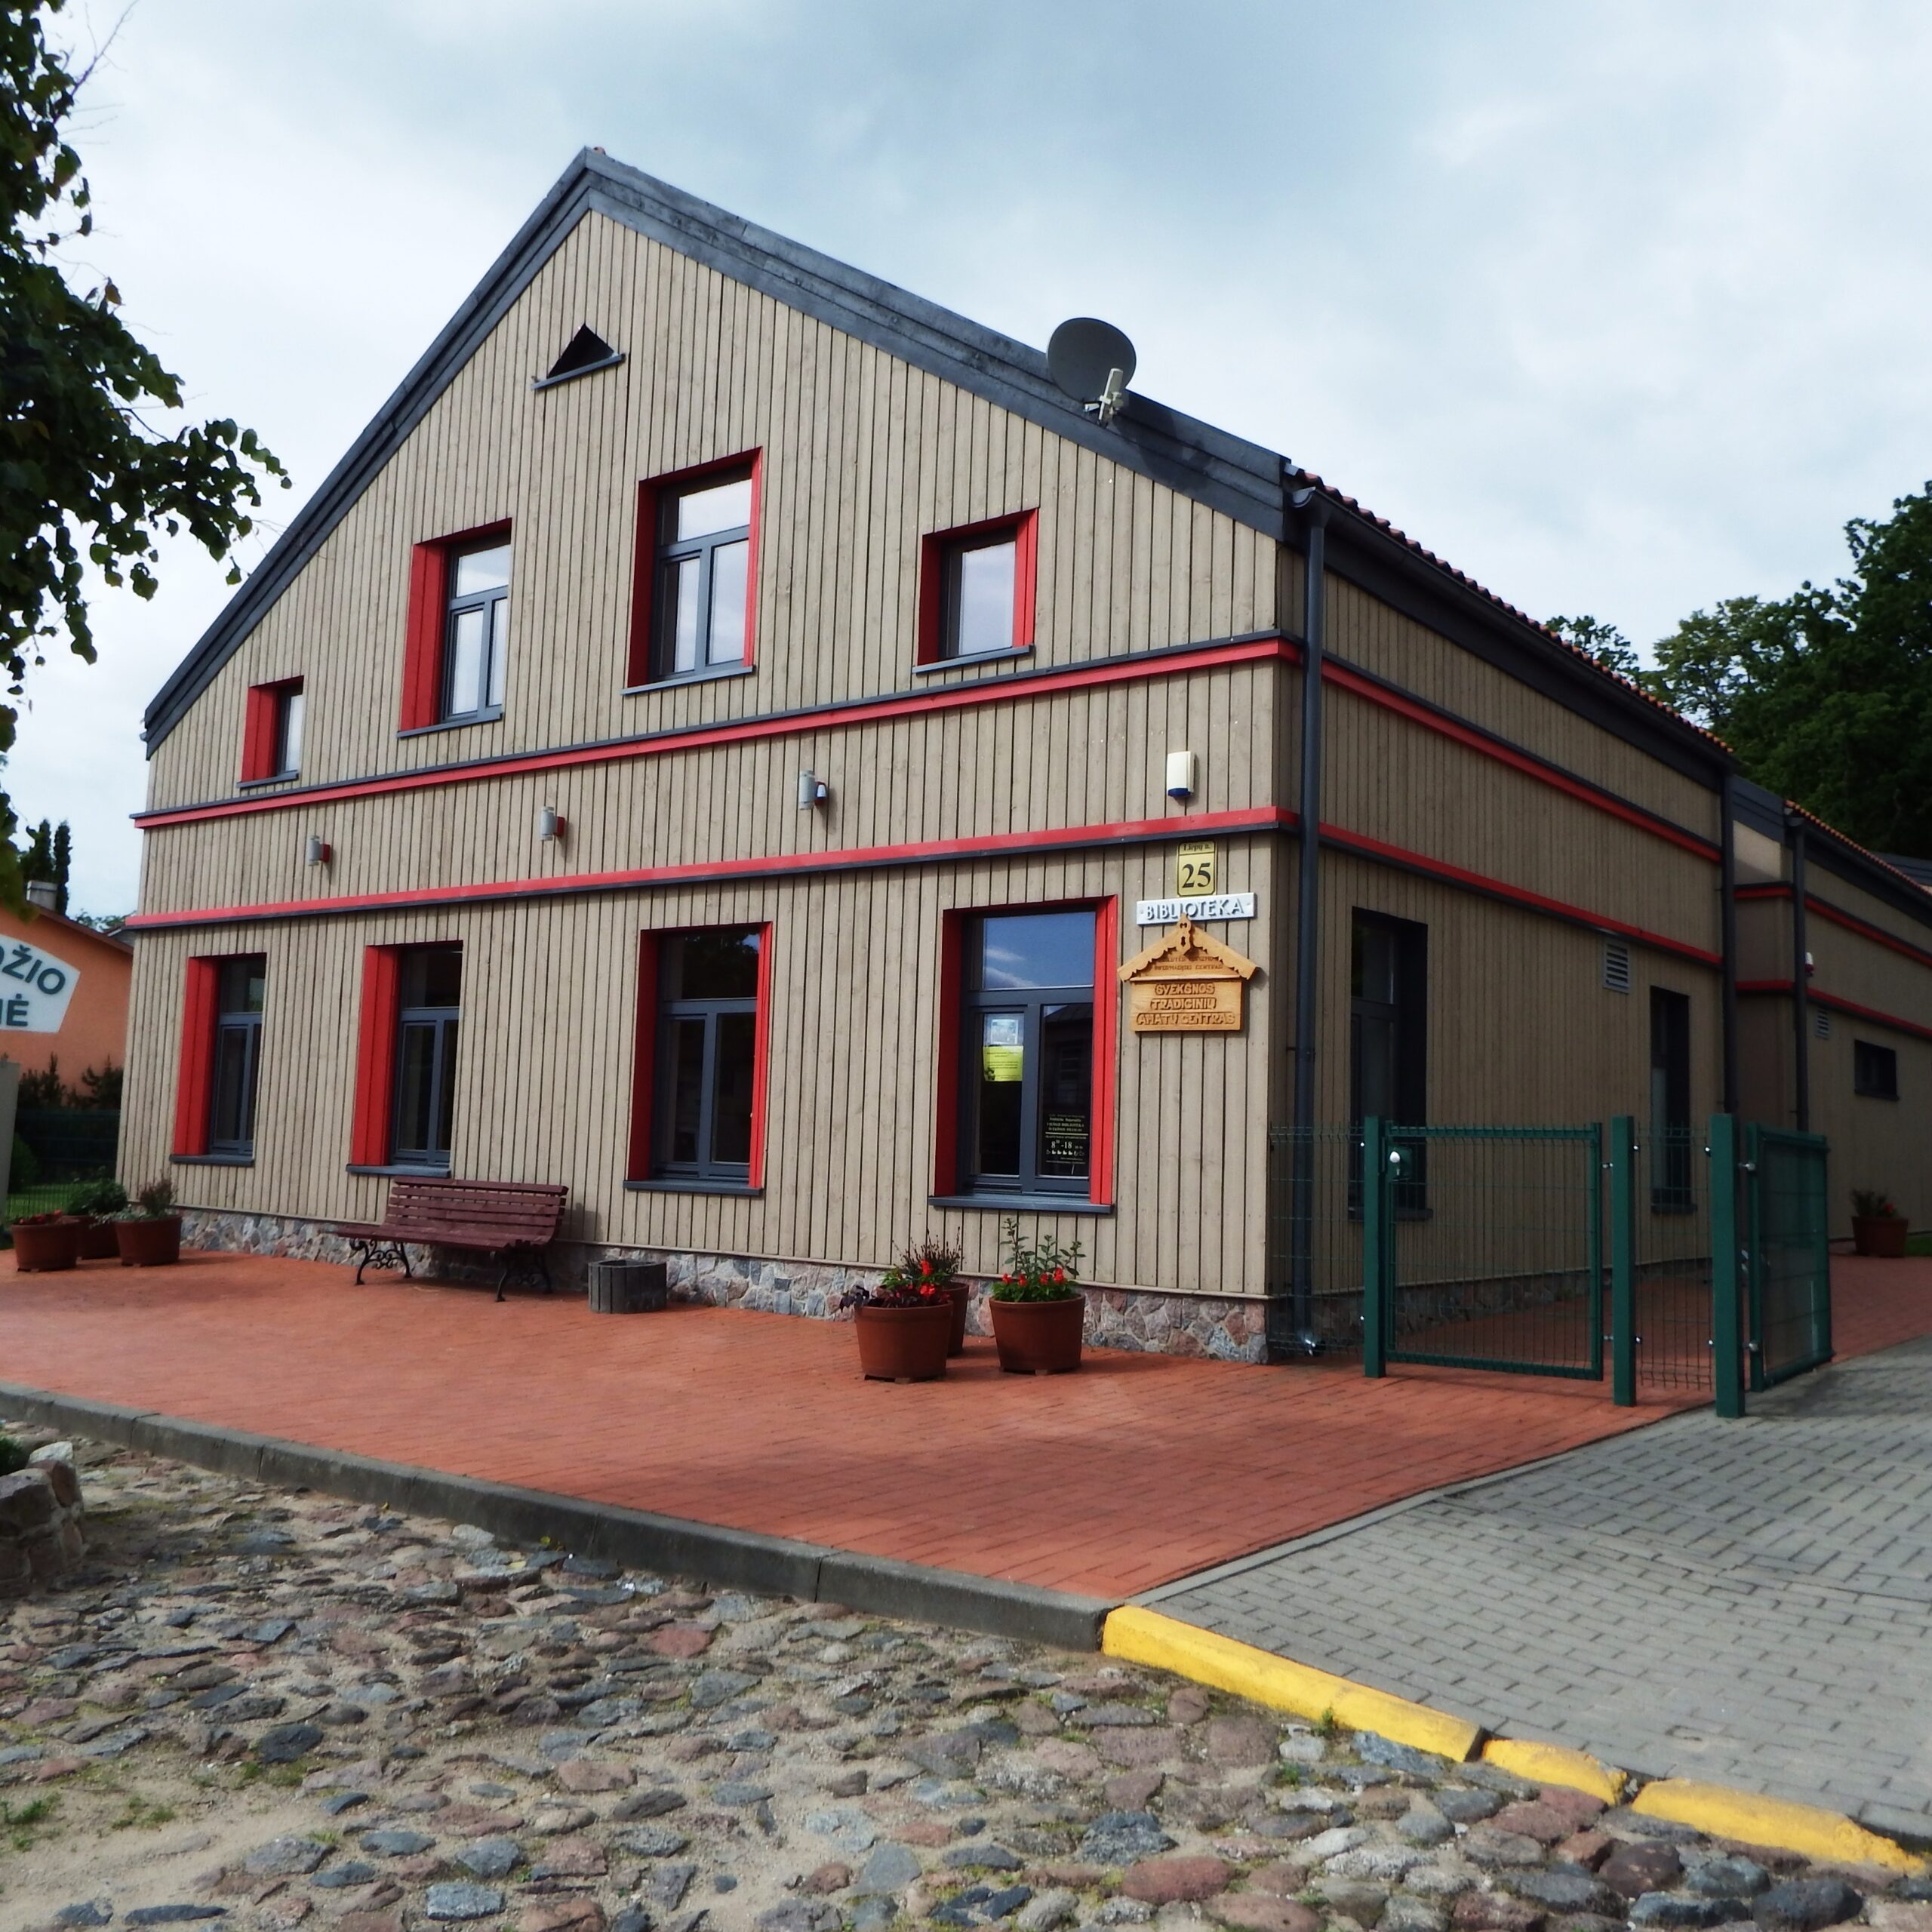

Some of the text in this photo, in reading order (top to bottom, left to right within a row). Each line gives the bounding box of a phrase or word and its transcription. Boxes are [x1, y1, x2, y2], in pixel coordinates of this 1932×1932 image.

[1182, 862, 1211, 888] 25
[1147, 897, 1244, 921] BIBLIOTEKA
[0, 943, 66, 995] ŽIO
[0, 993, 29, 1026] Ė
[1180, 1012, 1235, 1025] CENTRAS
